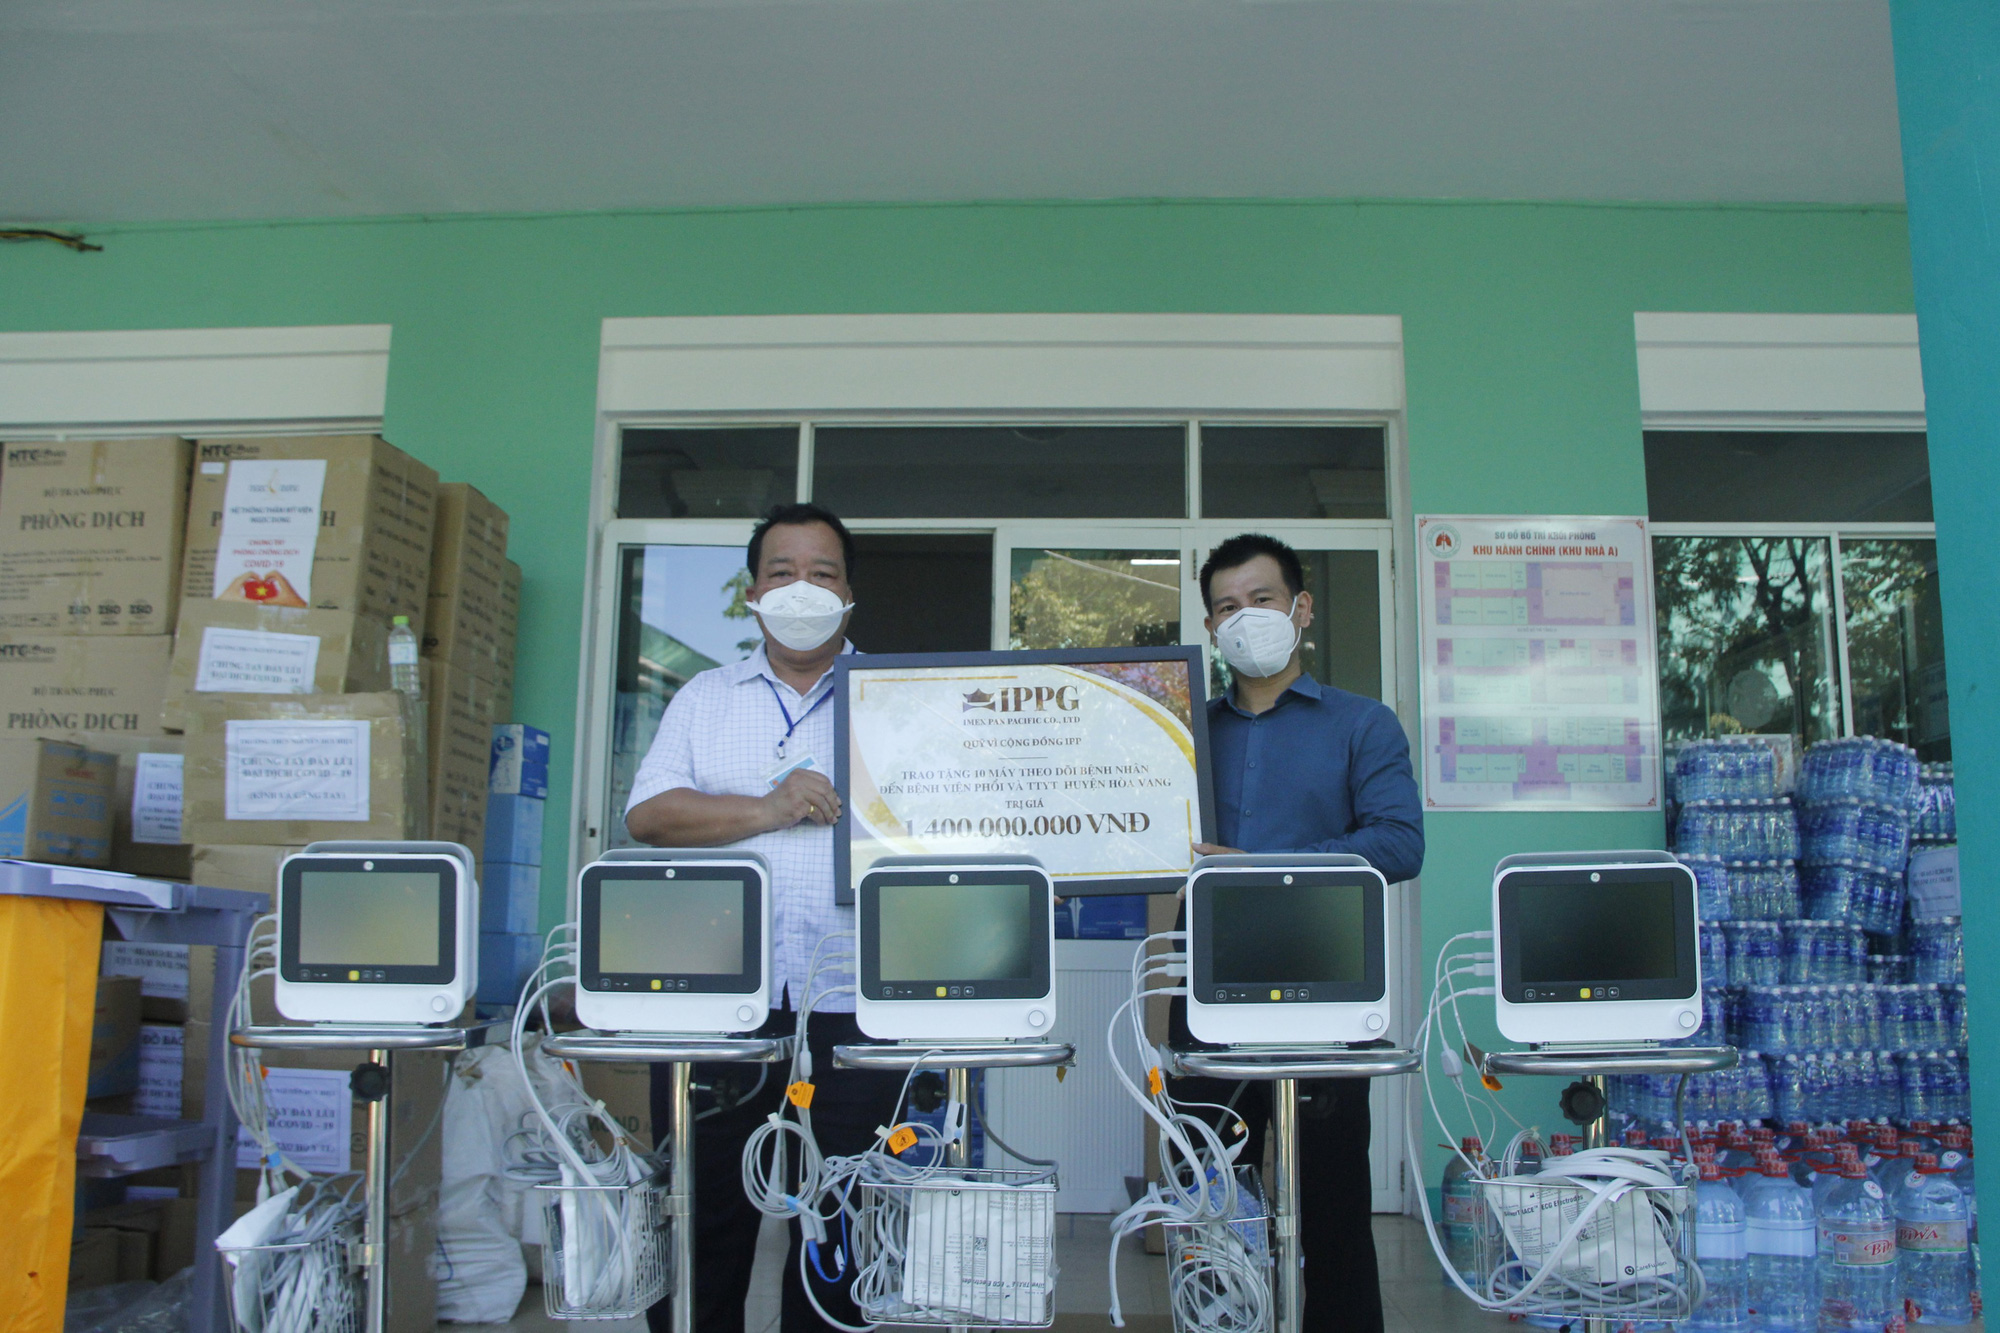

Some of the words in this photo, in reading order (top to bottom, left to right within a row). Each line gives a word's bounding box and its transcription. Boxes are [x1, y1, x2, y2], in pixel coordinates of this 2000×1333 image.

[20, 509, 86, 530] PHÒNG
[91, 510, 146, 530] DỊCH
[1473, 545, 1493, 555] KHU
[1495, 544, 1523, 555] HÀNH
[1525, 543, 1556, 556] CHÍNH
[1558, 545, 1582, 557] (KHU
[1584, 544, 1605, 556] NHÀ
[1608, 545, 1618, 557] A)
[999, 685, 1080, 712] IPPG
[7, 708, 78, 729] PHÒNG
[963, 718, 985, 726] IMEX
[988, 718, 1005, 726] PAN
[1007, 717, 1042, 725] PACIFIC
[1063, 716, 1080, 724] LTD
[1000, 738, 1030, 749] CỘNG
[1065, 737, 1082, 745] IPP
[901, 770, 935, 780] TRAO
[937, 768, 970, 781] TẶNG
[974, 769, 986, 778] 10
[988, 766, 1016, 778] MÁY
[1020, 767, 1052, 777] THEO
[1055, 765, 1078, 776] DÕI
[1080, 764, 1112, 778] BỆNH
[1115, 763, 1149, 775] NHÂN
[880, 781, 904, 795] ĐẾN
[907, 782, 939, 796] BỆNH
[942, 782, 971, 794] VIỆN
[1007, 780, 1024, 792] VÀ
[1026, 781, 1058, 791] TTYT
[1064, 778, 1105, 791] HUYỆN
[1109, 777, 1135, 788] HÒA
[1137, 778, 1171, 788] VANG
[1005, 800, 1023, 810] TRỊ
[1025, 798, 1044, 808] GIÁ
[905, 814, 1082, 840] 1.400.000.000
[1085, 812, 1150, 834] VNĐ
